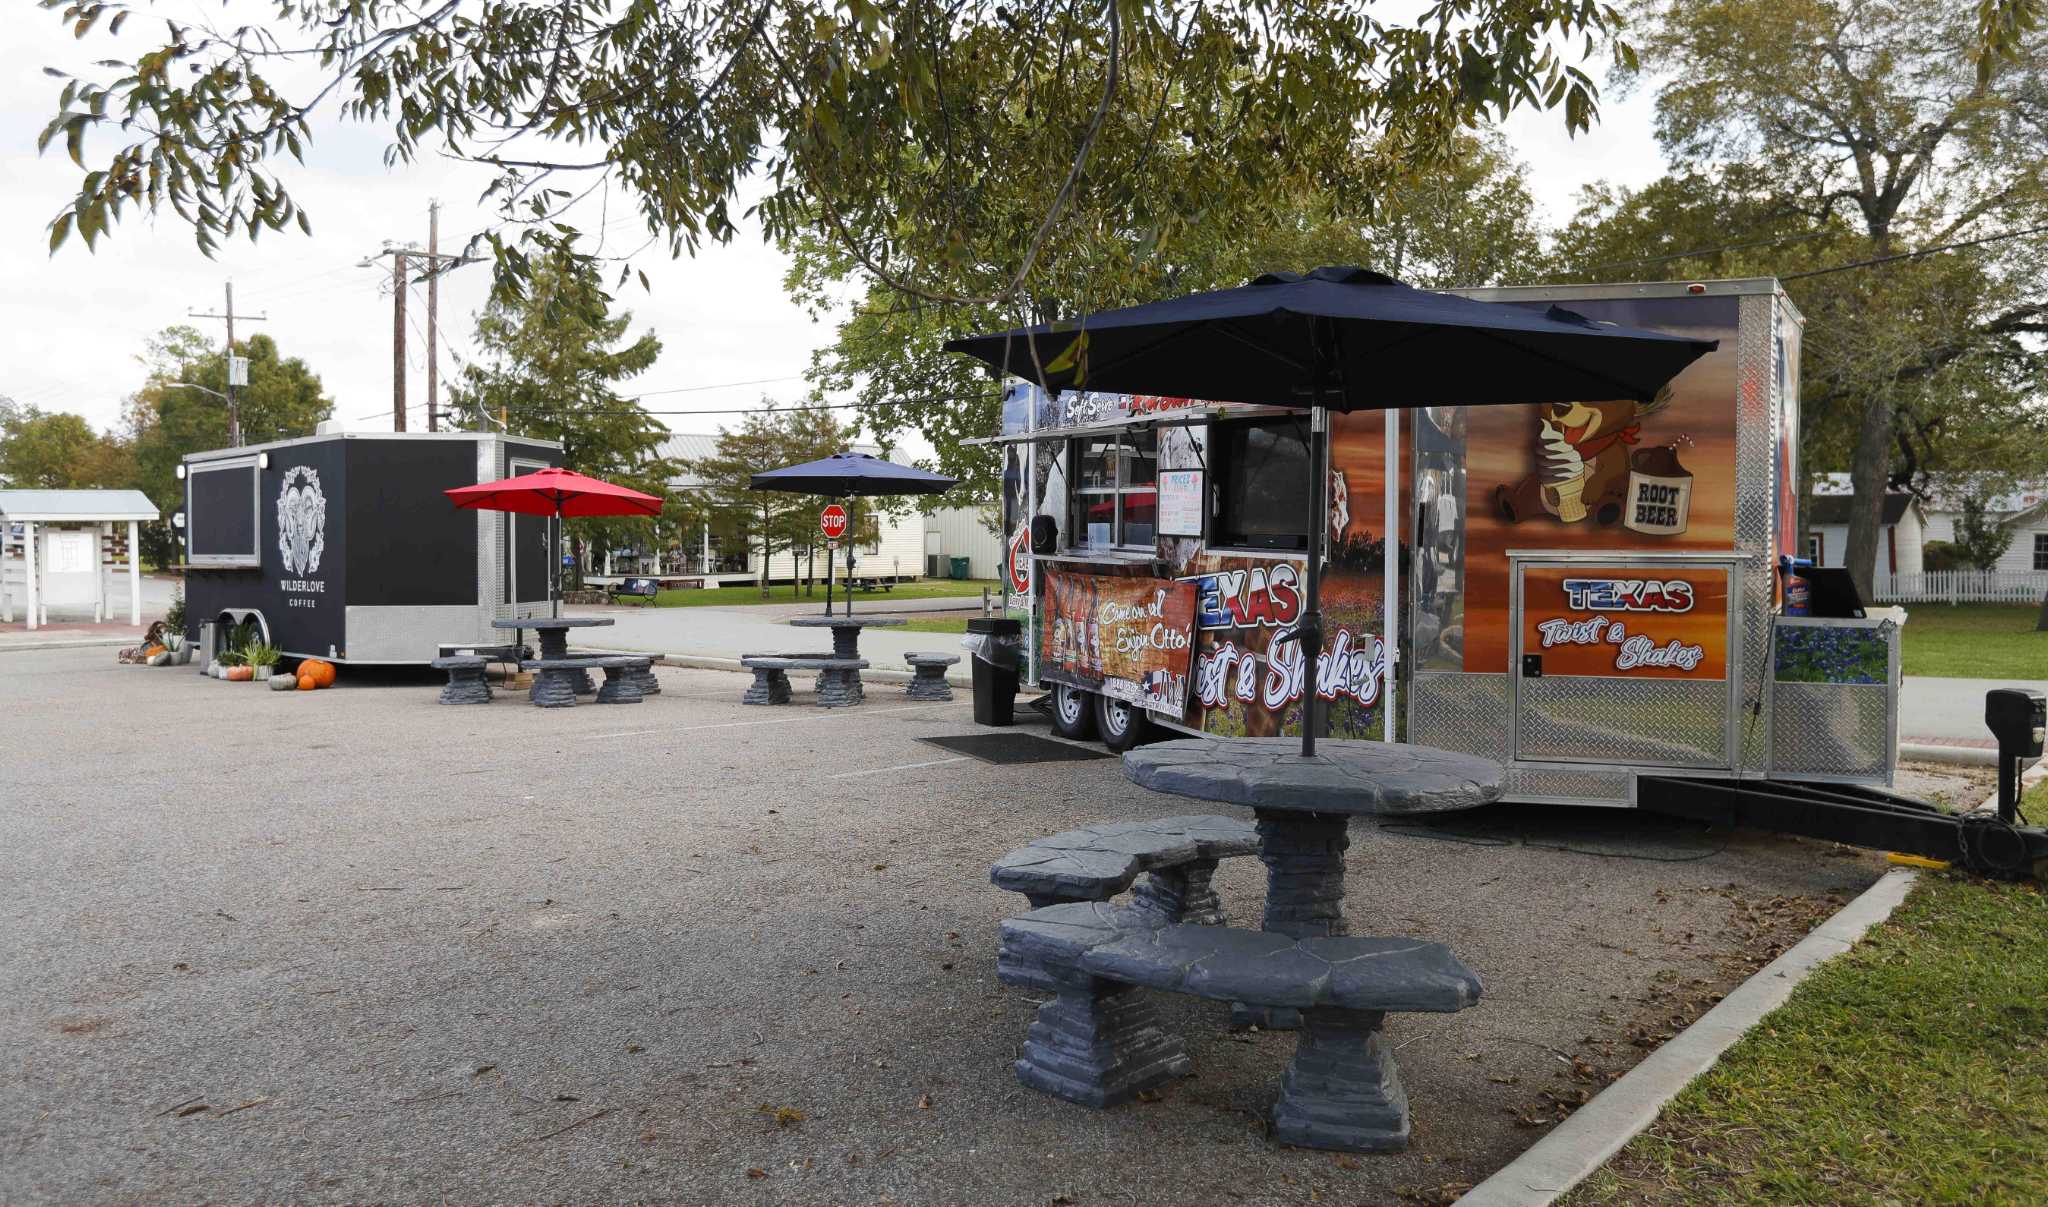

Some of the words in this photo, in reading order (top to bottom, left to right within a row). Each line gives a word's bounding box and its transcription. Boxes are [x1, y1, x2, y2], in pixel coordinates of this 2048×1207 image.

[1066, 394, 1088, 423] Soft
[1087, 391, 1114, 416] Serve
[1637, 483, 1680, 506] ROOT
[822, 515, 845, 528] STOP
[1634, 503, 1678, 527] BEER
[280, 579, 325, 593] WILDERLOVE
[1192, 564, 1302, 631] EXAS
[1563, 578, 1694, 613] TEXAS
[289, 598, 316, 608] COFFEE
[1101, 601, 1131, 625] Come
[1538, 616, 1609, 647] Twist
[1606, 623, 1625, 642] &
[1617, 634, 1703, 670] Shakes
[1236, 652, 1257, 700] &
